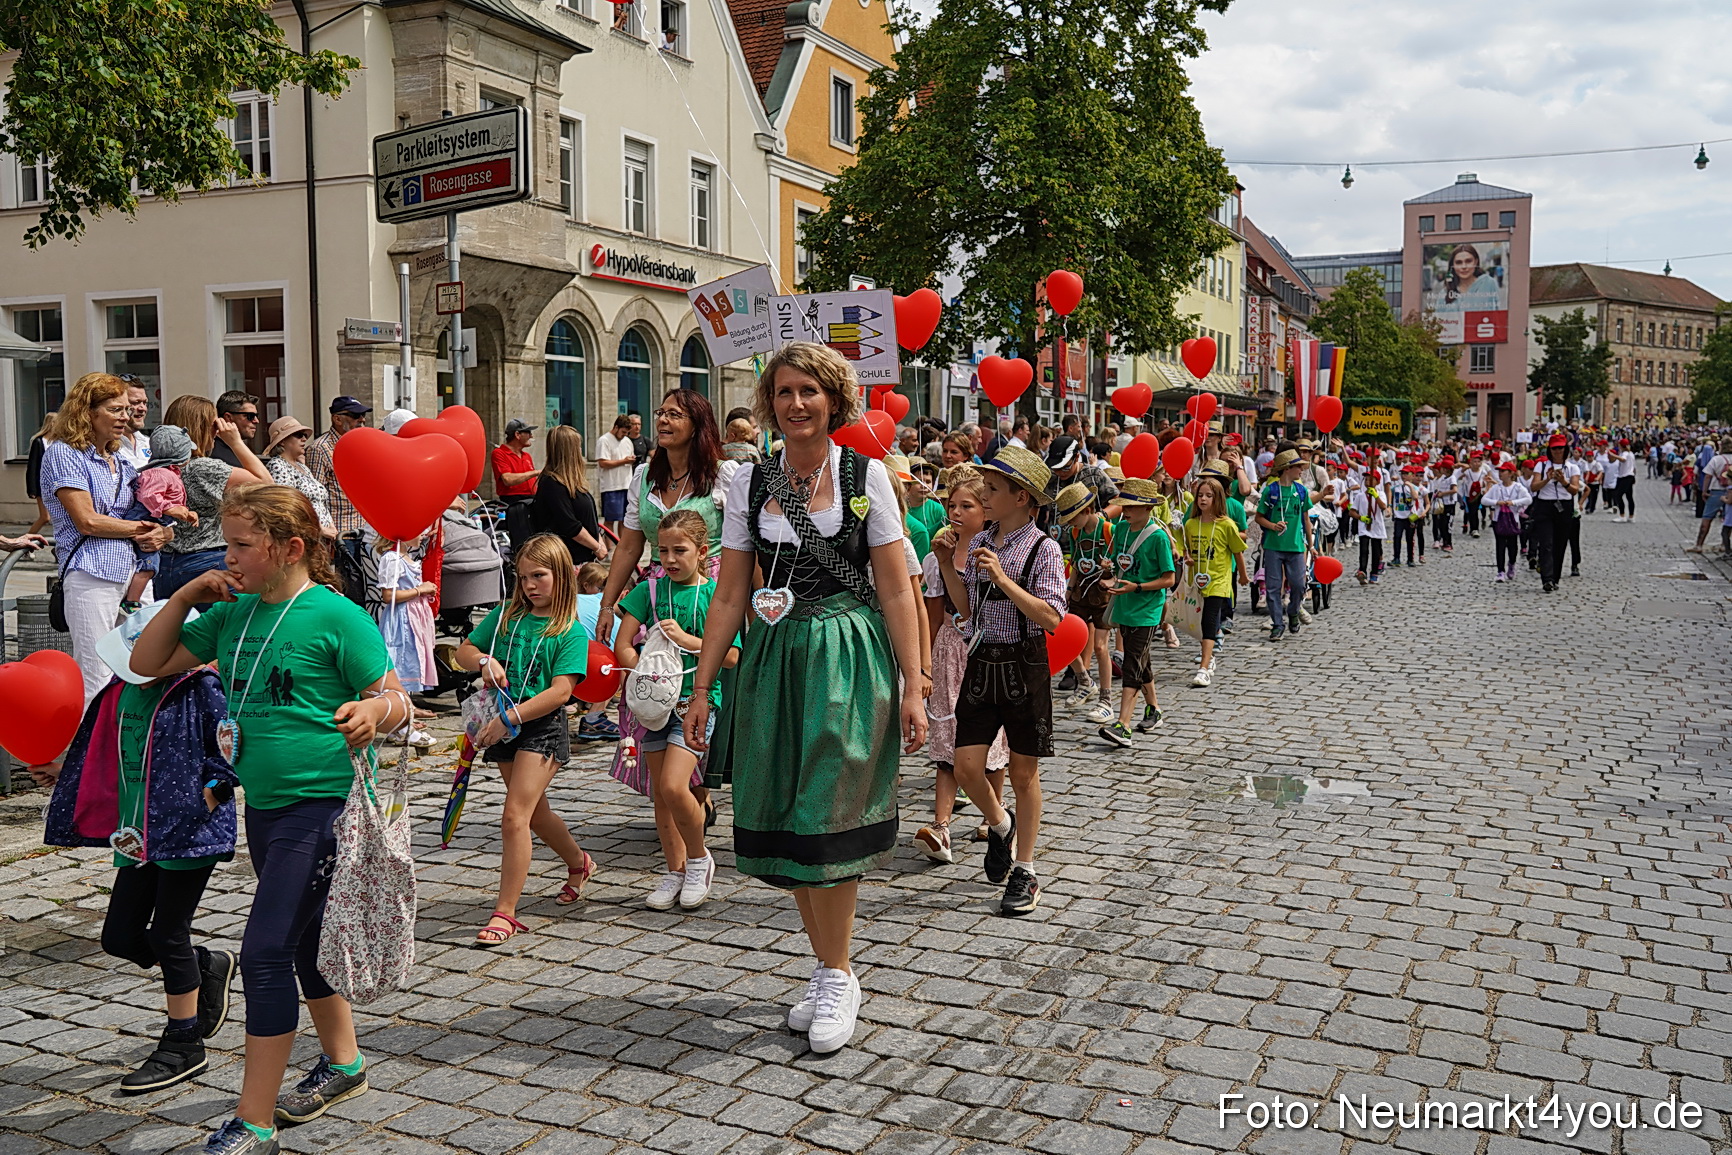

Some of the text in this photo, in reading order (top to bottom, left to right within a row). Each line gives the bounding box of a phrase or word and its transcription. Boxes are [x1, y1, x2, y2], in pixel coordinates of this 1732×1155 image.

[396, 128, 490, 164] Parkleitsystem
[429, 169, 493, 194] Rosengasse
[415, 251, 446, 271] Rosengass
[606, 247, 698, 285] HypoVereinsbank
[730, 321, 767, 339] Bildung durch
[733, 335, 757, 348] Sprache
[756, 330, 768, 341] und
[1361, 406, 1393, 417] Schule
[1353, 420, 1399, 431] Wolfstein
